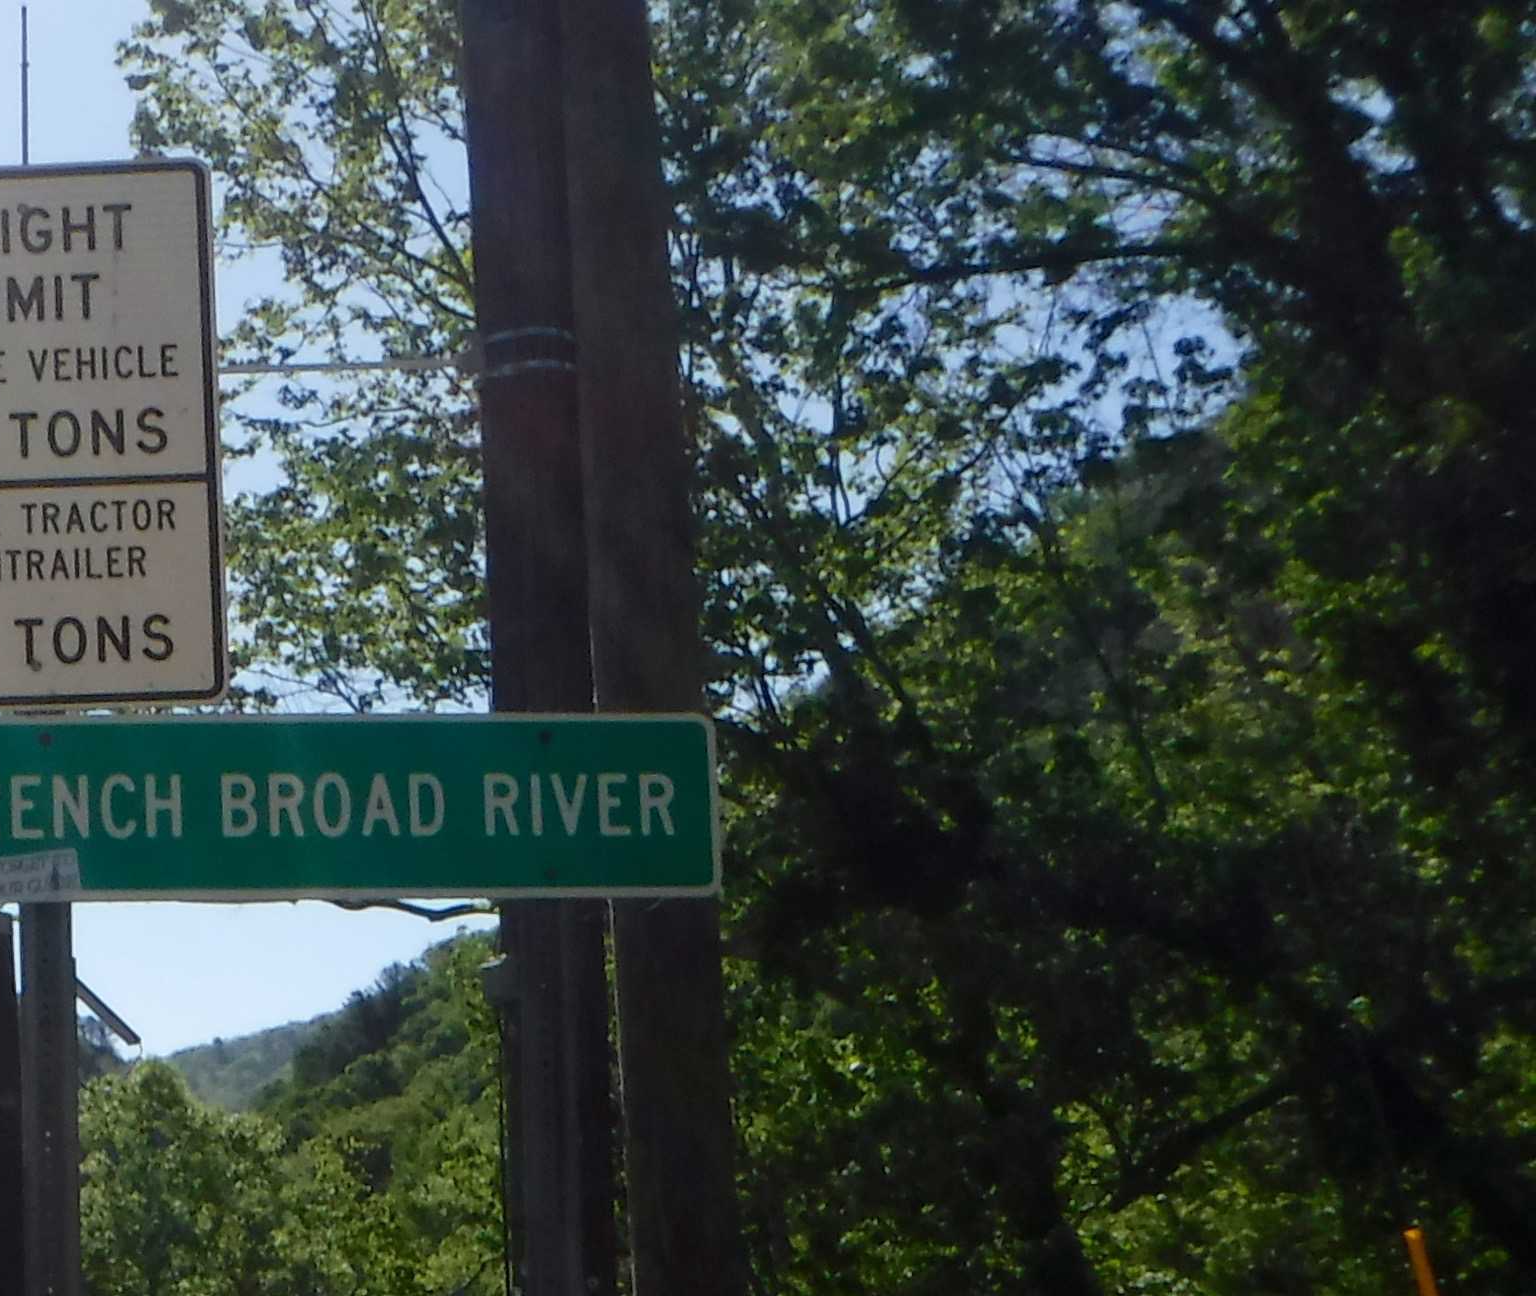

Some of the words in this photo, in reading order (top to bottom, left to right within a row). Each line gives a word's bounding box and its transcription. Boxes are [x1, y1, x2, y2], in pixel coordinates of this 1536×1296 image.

[28, 344, 179, 382] VEHICLE
[9, 407, 169, 460] TONS
[21, 498, 177, 535] TRACTOR
[14, 613, 174, 669] TONS
[220, 771, 446, 839] BROAD
[483, 771, 677, 838] RIVER
